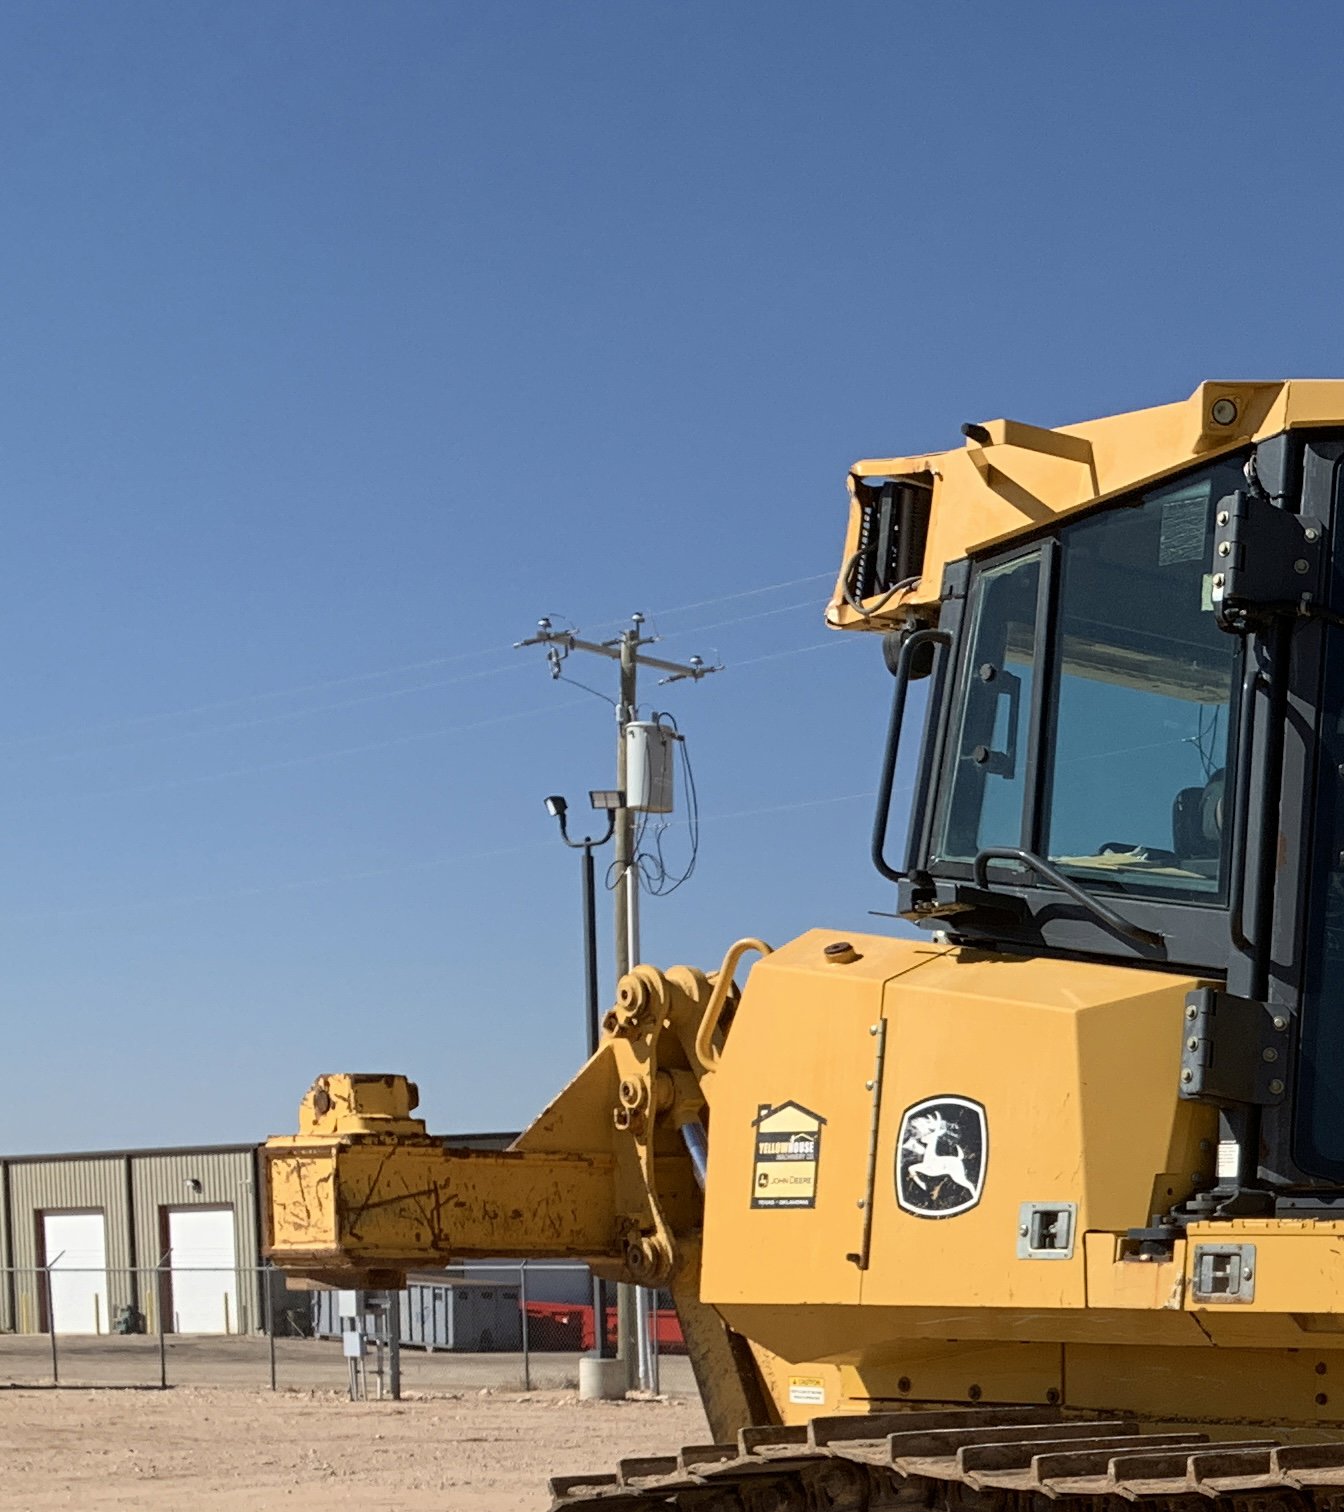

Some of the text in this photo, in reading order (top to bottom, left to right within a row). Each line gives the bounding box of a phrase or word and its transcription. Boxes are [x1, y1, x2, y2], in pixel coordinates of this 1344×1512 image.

[759, 1141, 814, 1154] YELLOWHOUSE
[771, 1176, 811, 1185] JOHN DEERE
